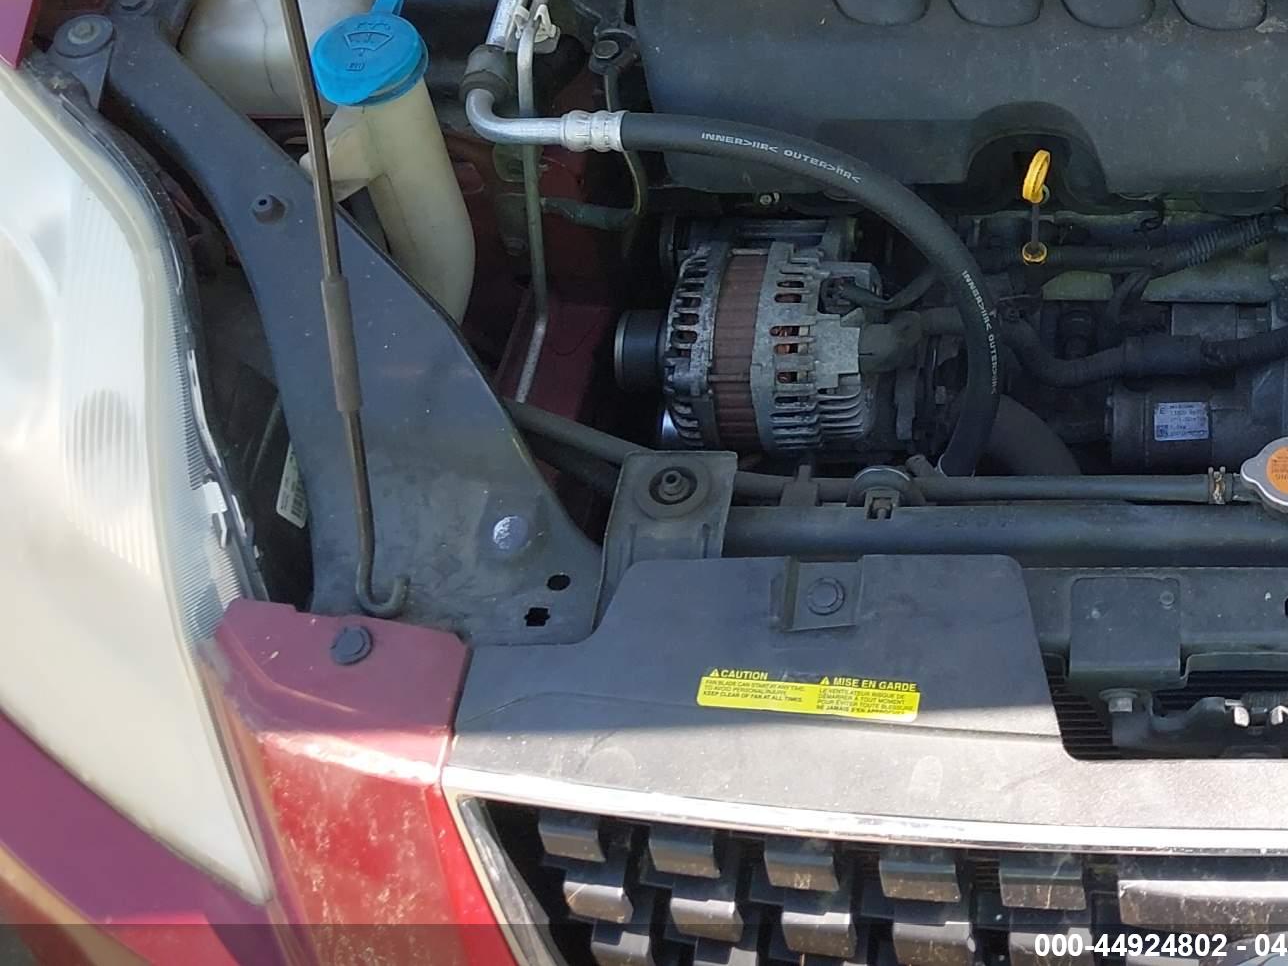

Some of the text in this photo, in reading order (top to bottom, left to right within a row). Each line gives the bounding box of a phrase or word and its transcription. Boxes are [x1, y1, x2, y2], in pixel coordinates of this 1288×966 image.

[720, 669, 769, 681] CAUTION
[833, 677, 917, 692] MISE EN GARDE
